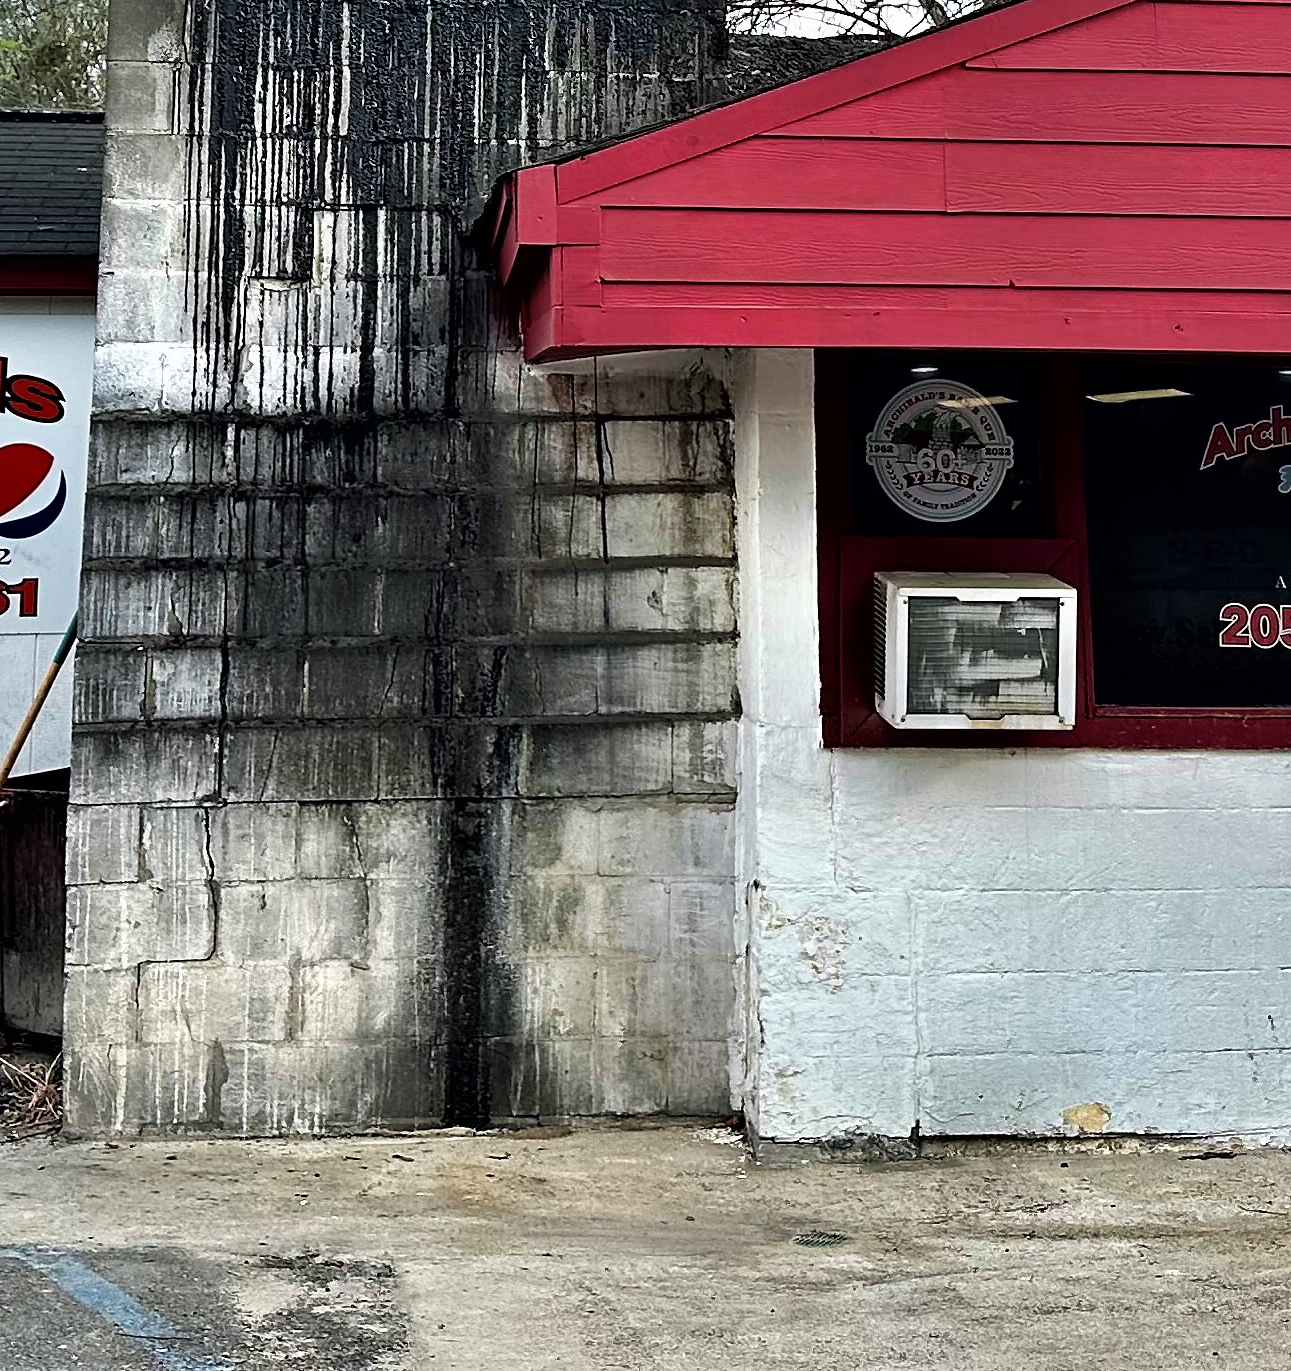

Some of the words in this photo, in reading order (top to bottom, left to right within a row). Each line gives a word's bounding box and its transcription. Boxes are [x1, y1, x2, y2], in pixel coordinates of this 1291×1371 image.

[883, 391, 945, 438] ARCHIBALD'S
[868, 444, 894, 453] 1962
[984, 447, 1011, 456] 2022
[910, 472, 969, 485] YEARS
[940, 493, 976, 510] TRADITION
[1275, 576, 1288, 589] A
